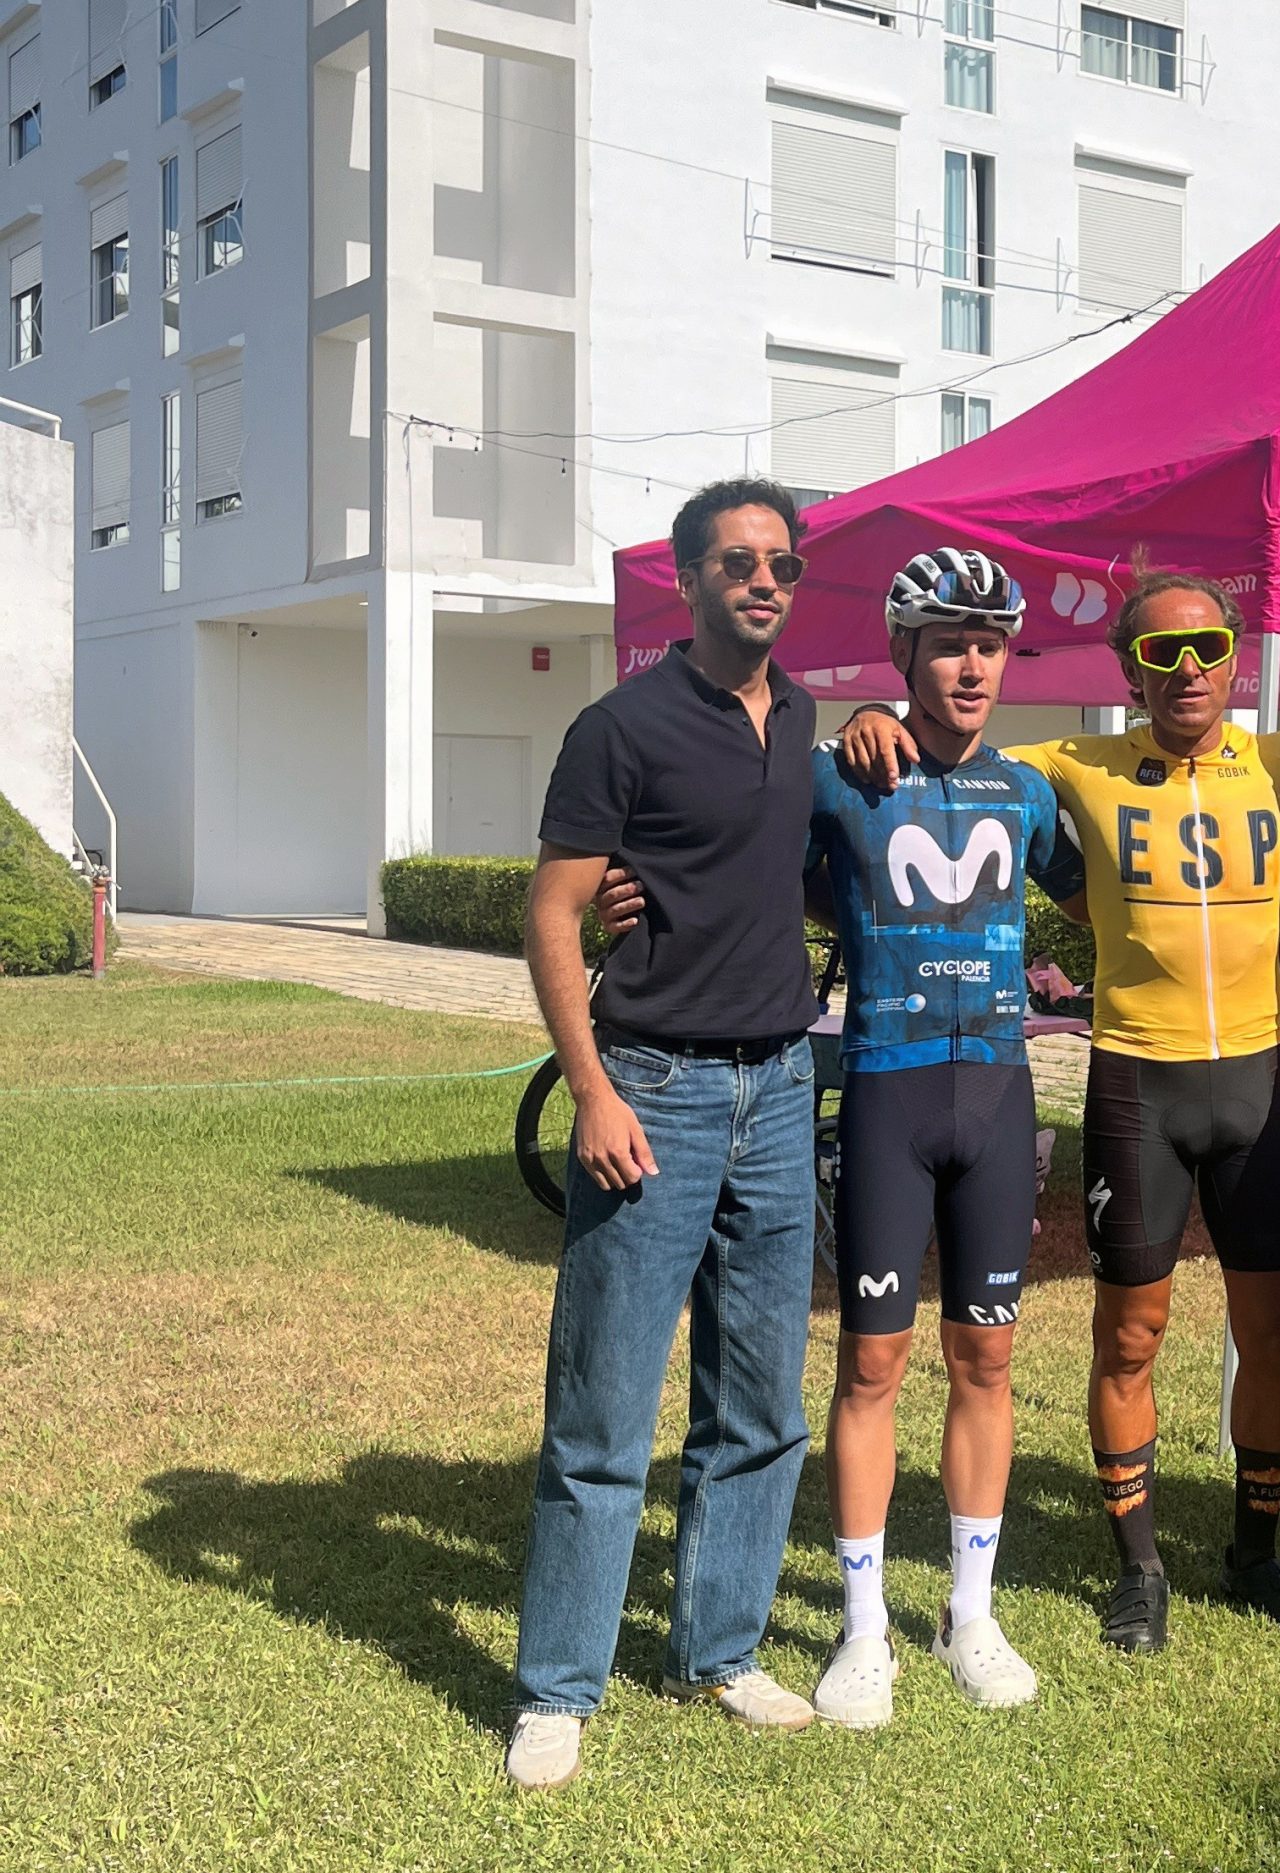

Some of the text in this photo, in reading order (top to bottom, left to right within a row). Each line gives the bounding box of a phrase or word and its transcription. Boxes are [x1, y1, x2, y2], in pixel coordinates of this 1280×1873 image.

[624, 640, 670, 673] fun
[1217, 766, 1250, 779] GOBIK
[952, 778, 1011, 791] CANYON
[1117, 803, 1279, 891] ESP
[918, 960, 991, 977] CYCLOPE
[986, 1270, 1020, 1284] GOBIK
[1106, 1479, 1144, 1496] FUEGO
